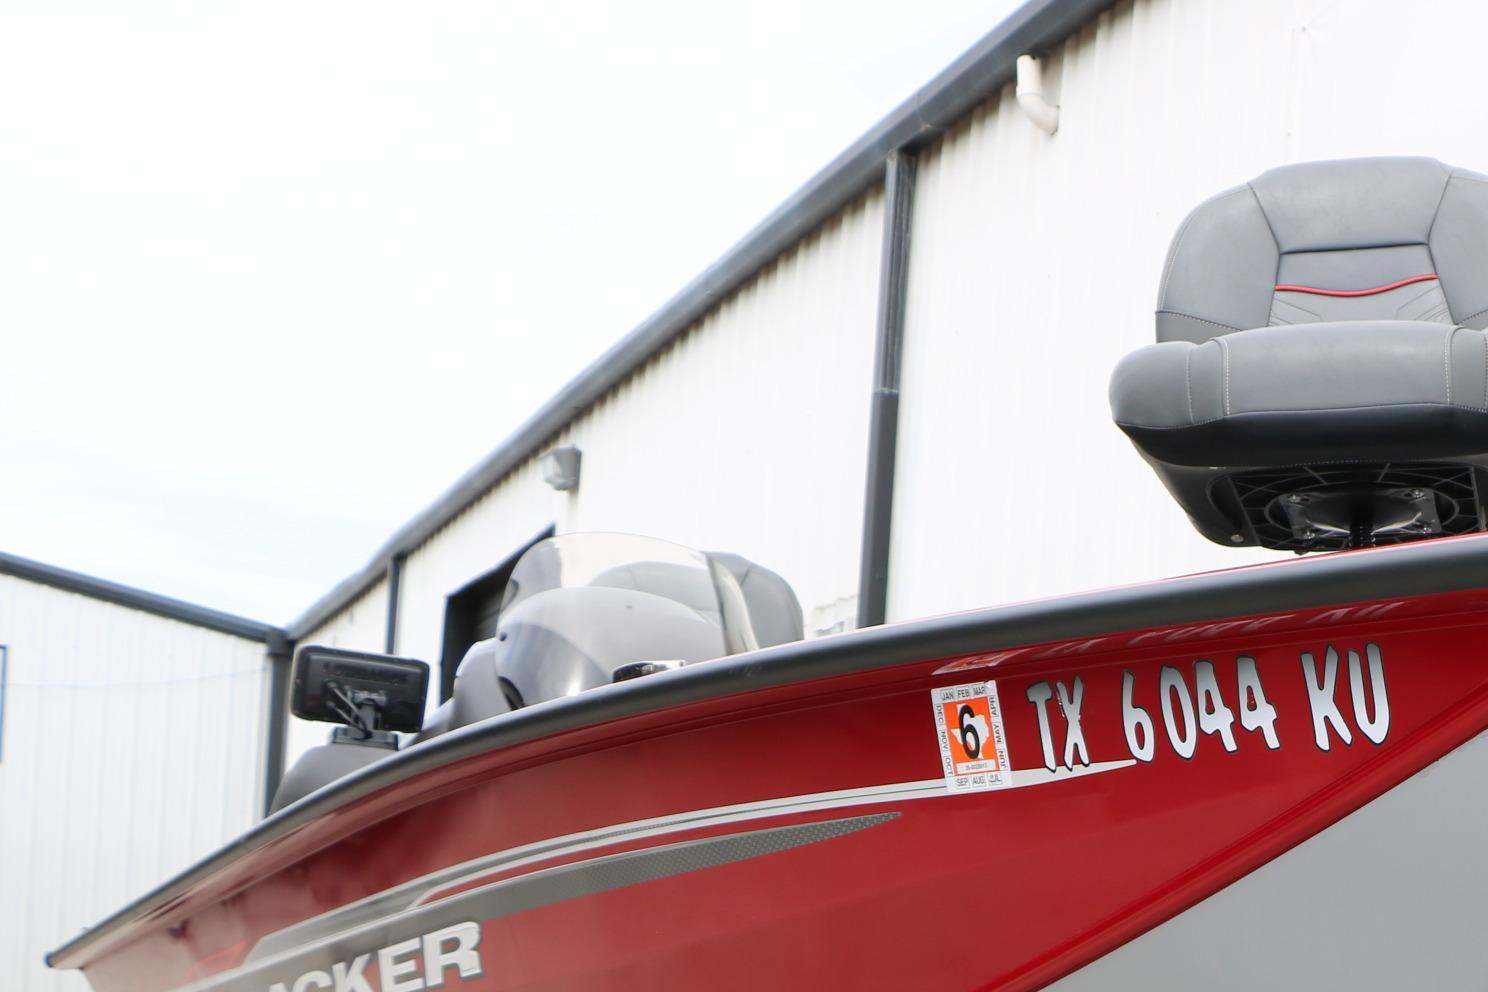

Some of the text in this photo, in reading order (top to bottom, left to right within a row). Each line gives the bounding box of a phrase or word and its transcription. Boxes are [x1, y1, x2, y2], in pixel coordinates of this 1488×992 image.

[957, 689, 970, 698] FEB
[1026, 642, 1391, 773] TX 6044 KU
[959, 705, 980, 759] 6
